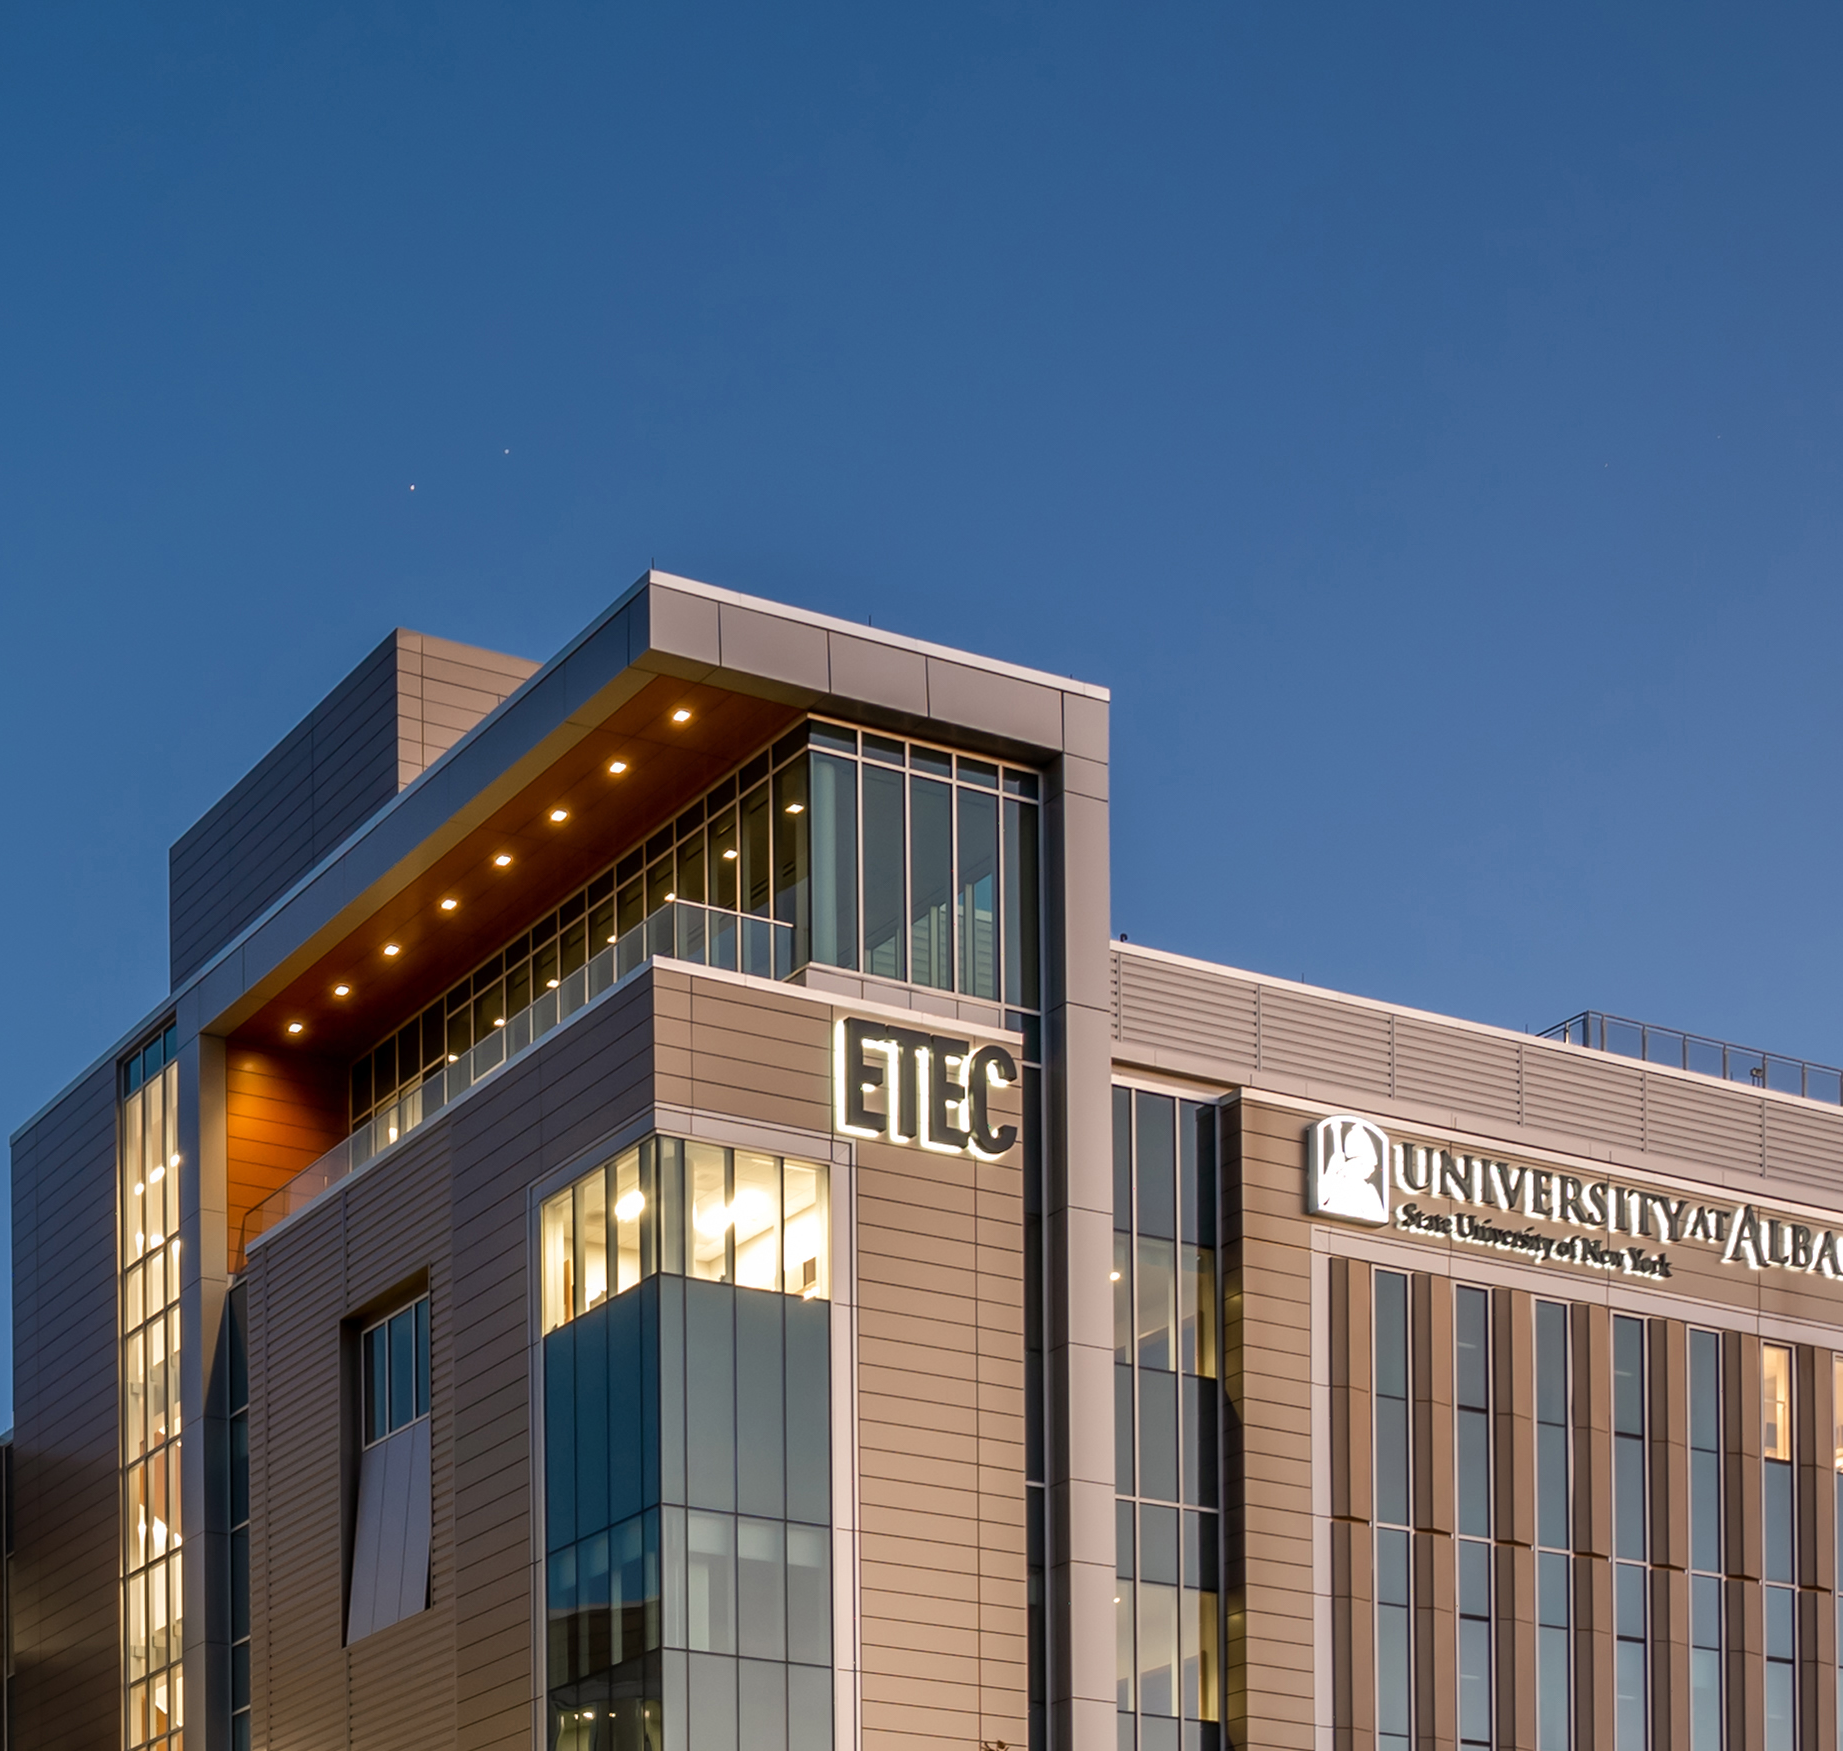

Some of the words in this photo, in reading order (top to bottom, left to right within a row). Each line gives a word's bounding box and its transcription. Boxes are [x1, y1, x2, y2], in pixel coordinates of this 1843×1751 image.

[843, 1017, 1018, 1155] ETEC
[1398, 1142, 1689, 1242] UNIVERSITY
[1690, 1206, 1731, 1242] AT
[1400, 1203, 1452, 1235] State
[1455, 1213, 1556, 1261] University
[1556, 1236, 1581, 1259] of
[1581, 1238, 1625, 1268] New
[1625, 1247, 1673, 1278] York
